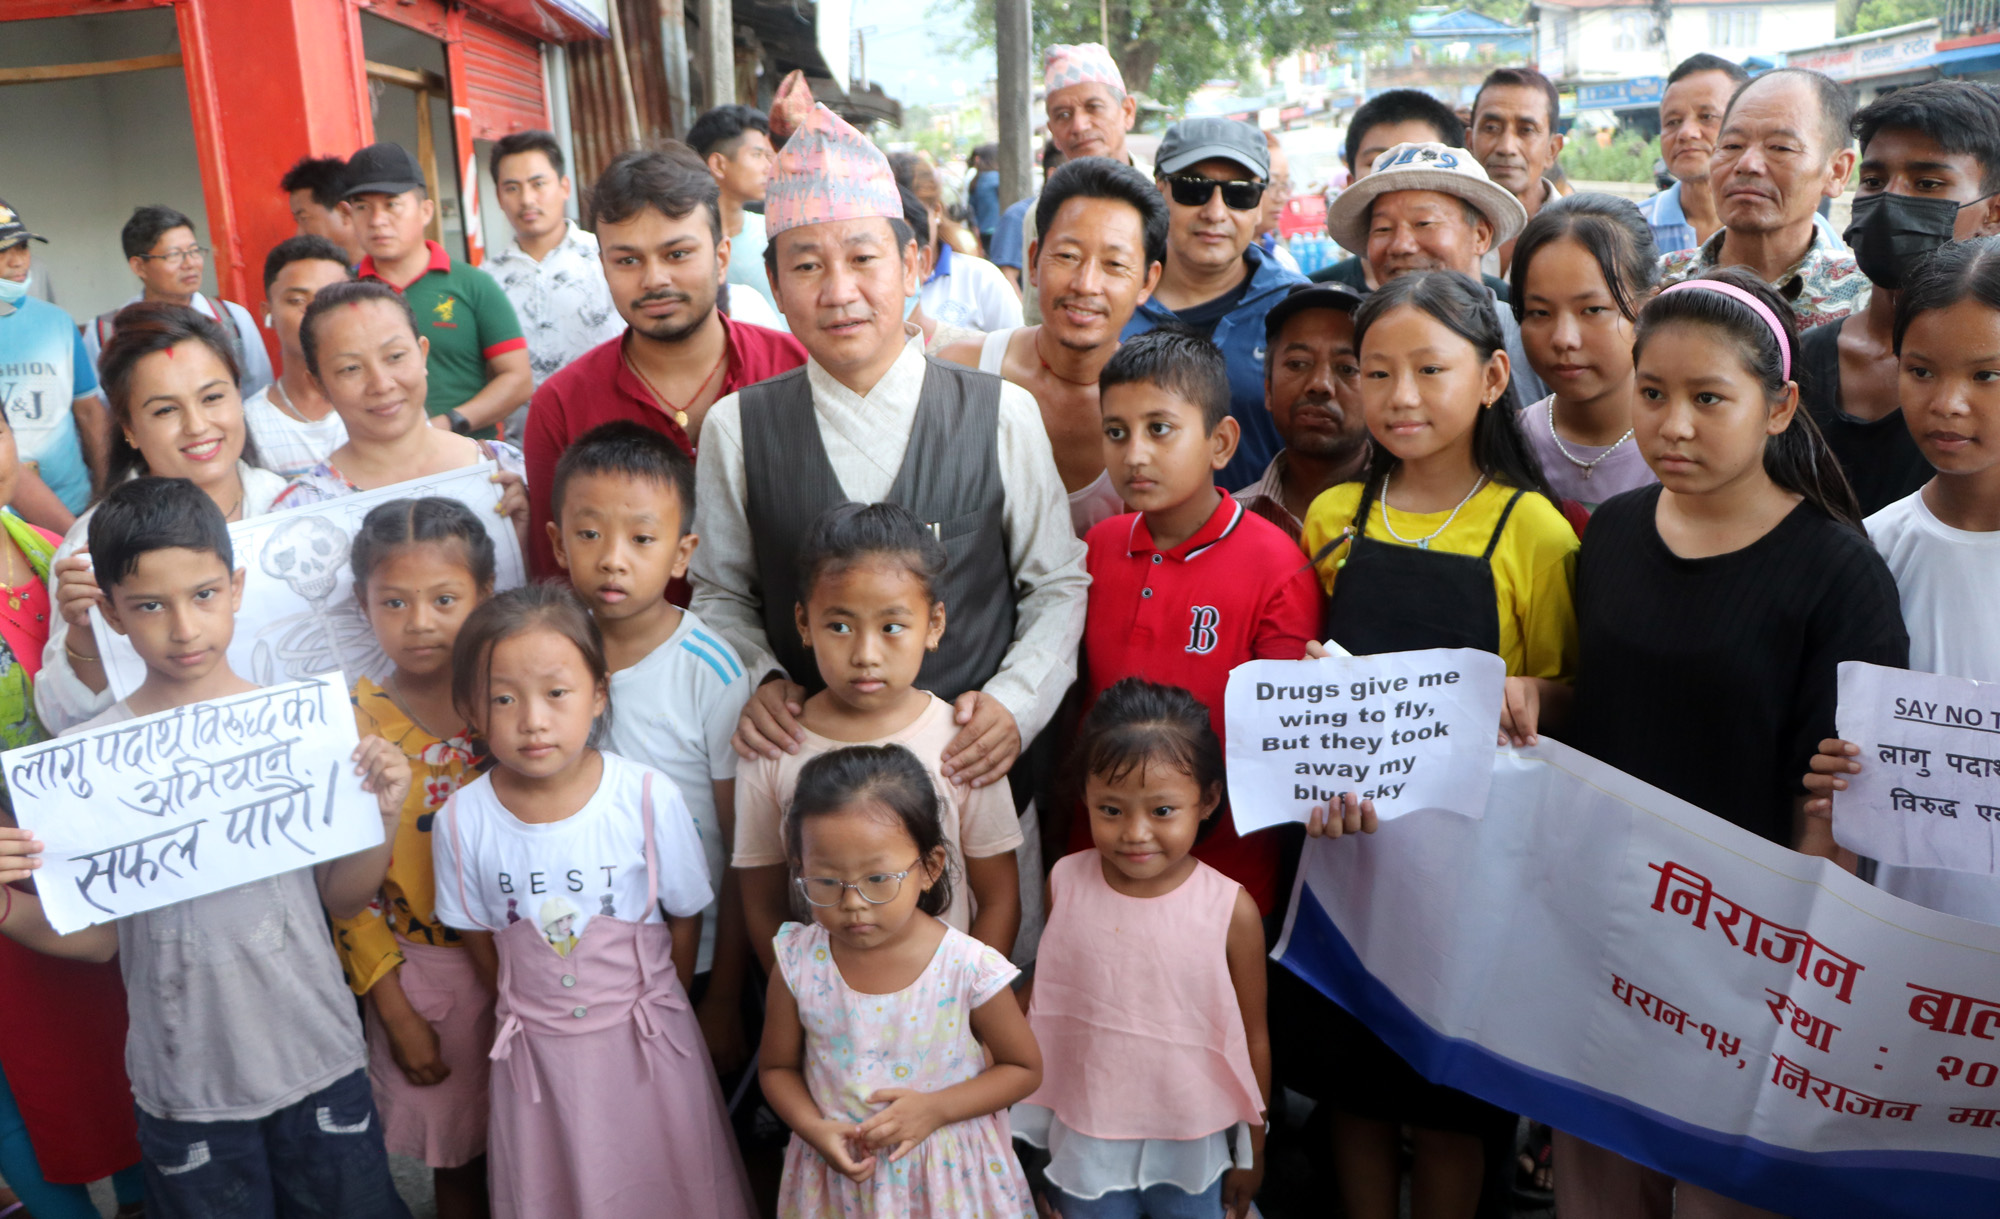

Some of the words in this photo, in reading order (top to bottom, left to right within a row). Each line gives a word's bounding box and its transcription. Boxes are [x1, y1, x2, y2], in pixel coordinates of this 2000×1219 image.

[1185, 605, 1220, 655] B
[1256, 681, 1339, 703] Drugs
[1350, 676, 1408, 701] give
[1419, 670, 1460, 688] me
[1279, 710, 1348, 728] wing
[1358, 707, 1386, 723] to
[1394, 700, 1435, 719] fly,
[1894, 697, 1938, 720] SAY
[1946, 705, 1982, 727] NO
[1262, 733, 1310, 751] But
[1320, 732, 1383, 755] they
[1391, 721, 1450, 746] took
[12, 738, 93, 799] लागु
[1295, 761, 1370, 782] away
[1379, 755, 1416, 776] my
[1877, 743, 1931, 777] लागु
[1363, 782, 1406, 801] sky
[1890, 788, 1960, 818] विरुद्ध
[67, 819, 208, 914] सफल
[498, 865, 618, 895] BEST
